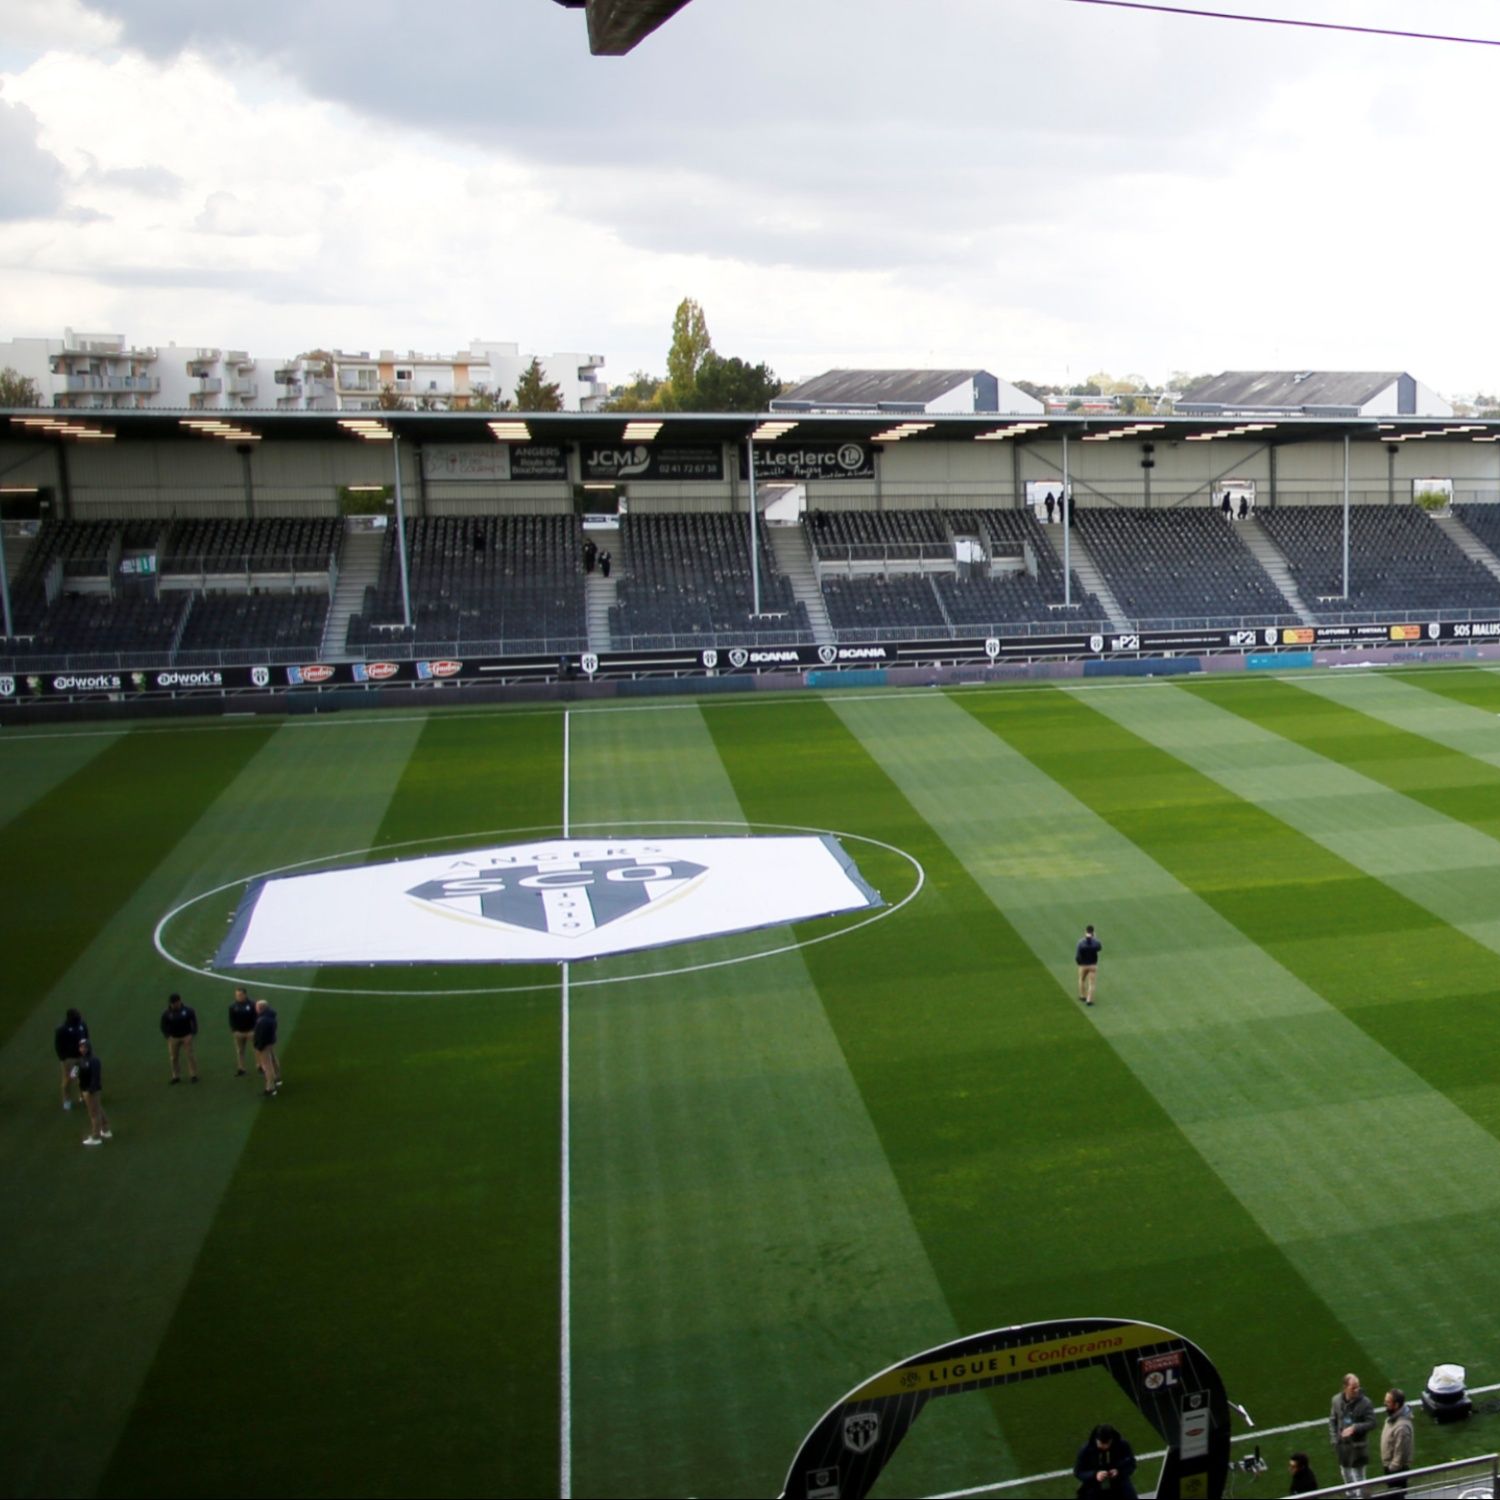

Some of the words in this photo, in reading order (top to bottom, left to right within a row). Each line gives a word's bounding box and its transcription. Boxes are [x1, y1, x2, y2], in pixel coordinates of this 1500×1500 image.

[515, 447, 560, 457] ANGERS
[587, 451, 632, 466] JCM
[753, 449, 836, 465] E.Leclerc
[1453, 623, 1470, 637] SOS
[750, 650, 799, 662] SCANIA
[838, 647, 886, 658] SCANIA
[441, 865, 673, 896] SCO
[929, 1357, 998, 1382] LIGUE
[1008, 1354, 1017, 1367] 1
[1027, 1335, 1124, 1364] Conforama
